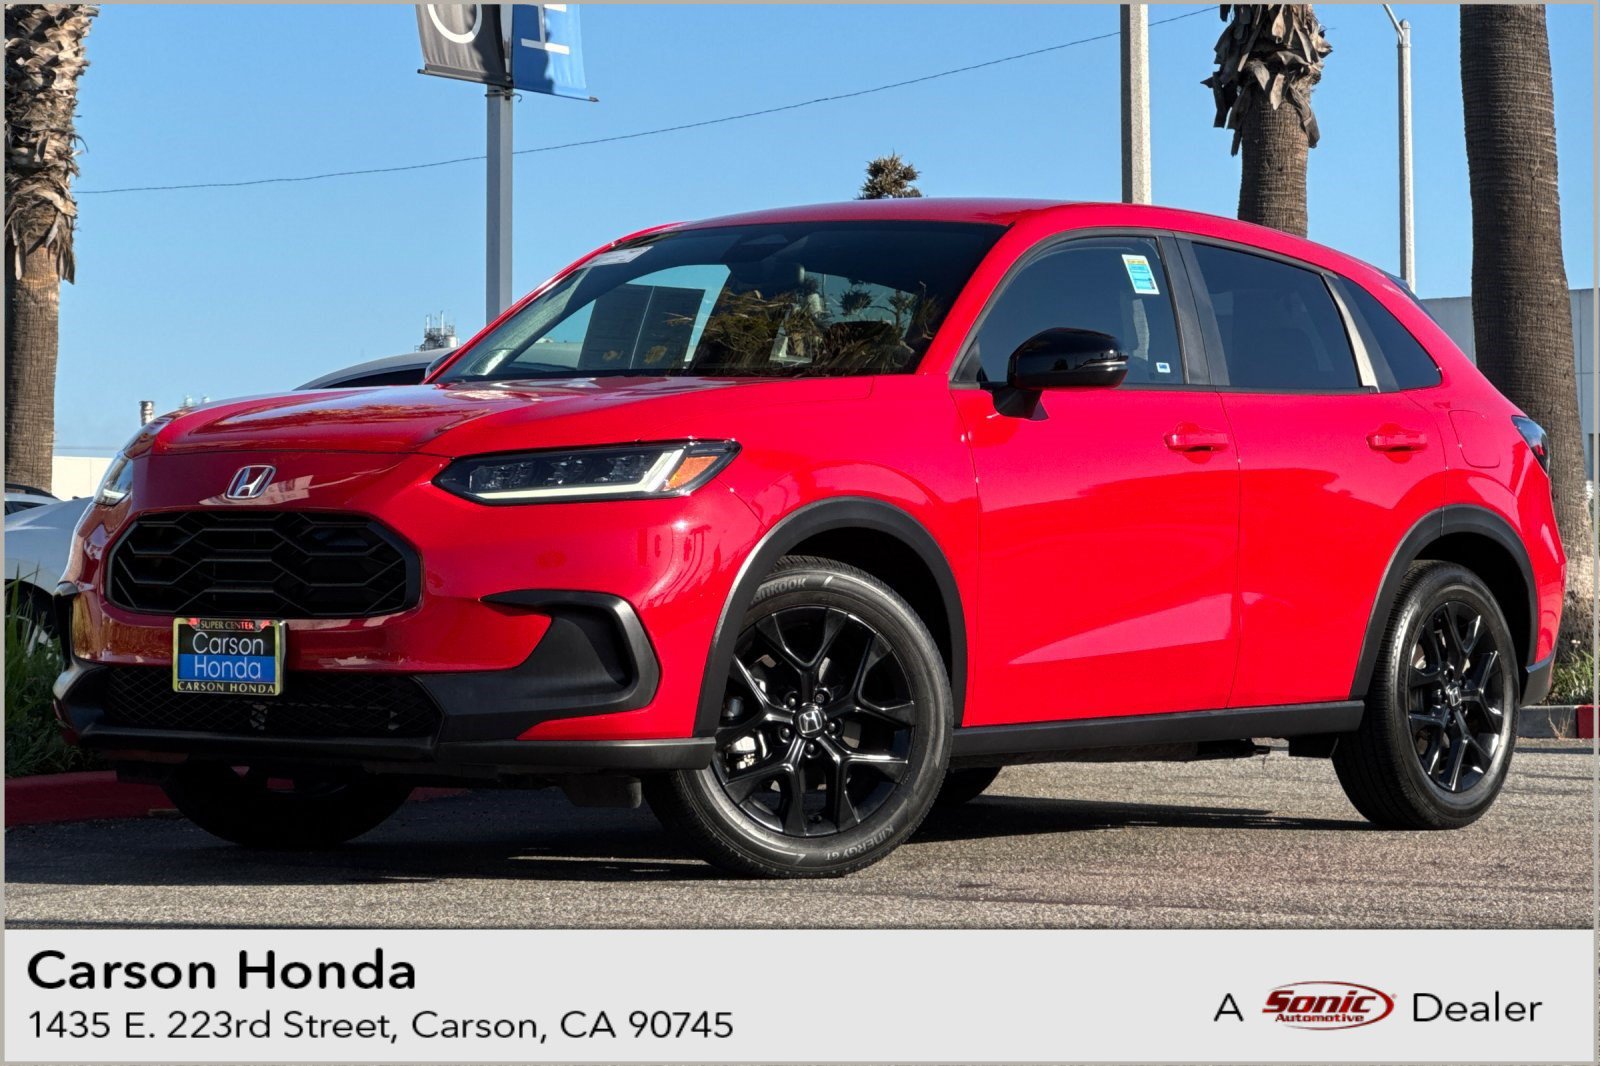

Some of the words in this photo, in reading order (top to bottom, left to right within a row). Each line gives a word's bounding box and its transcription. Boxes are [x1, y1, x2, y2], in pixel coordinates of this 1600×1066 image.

[200, 620, 223, 630] SUPER
[224, 620, 255, 630] CENTER
[192, 631, 264, 655] Carson
[194, 655, 261, 679] Honda
[178, 681, 225, 692] CARSON
[229, 683, 275, 694] HONDA
